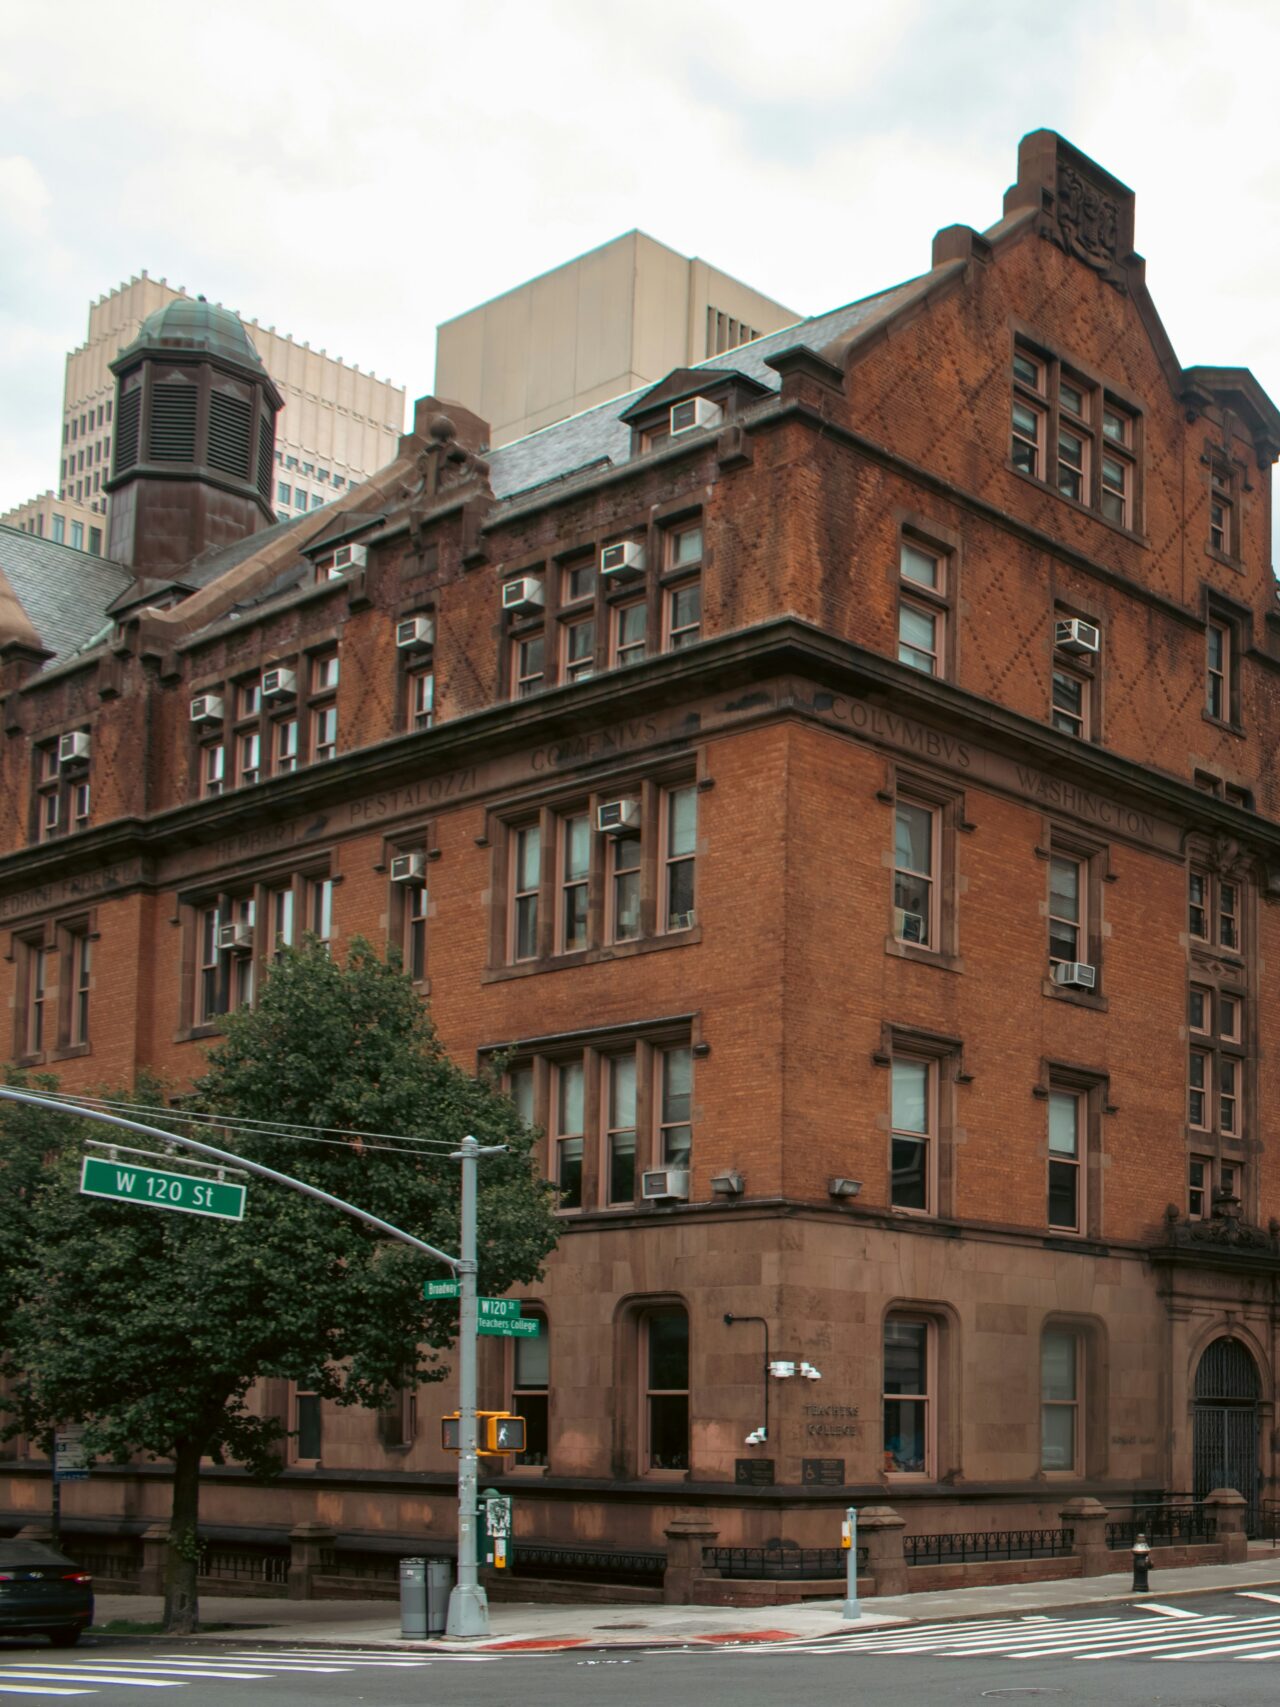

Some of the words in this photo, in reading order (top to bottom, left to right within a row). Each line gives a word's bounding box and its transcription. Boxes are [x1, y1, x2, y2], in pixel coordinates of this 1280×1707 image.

[831, 696, 971, 768] COLVMBVS
[350, 767, 476, 824] PESTALOZZI
[1015, 766, 1154, 836] WASHINGTON
[116, 1171, 136, 1193] W
[146, 1177, 183, 1202] 120
[192, 1186, 214, 1207] St
[428, 1282, 457, 1296] Broadway
[479, 1317, 509, 1330] Teachers
[510, 1320, 537, 1333] College
[805, 1405, 859, 1417] TEACHERS
[807, 1424, 857, 1437] COLLEGE
